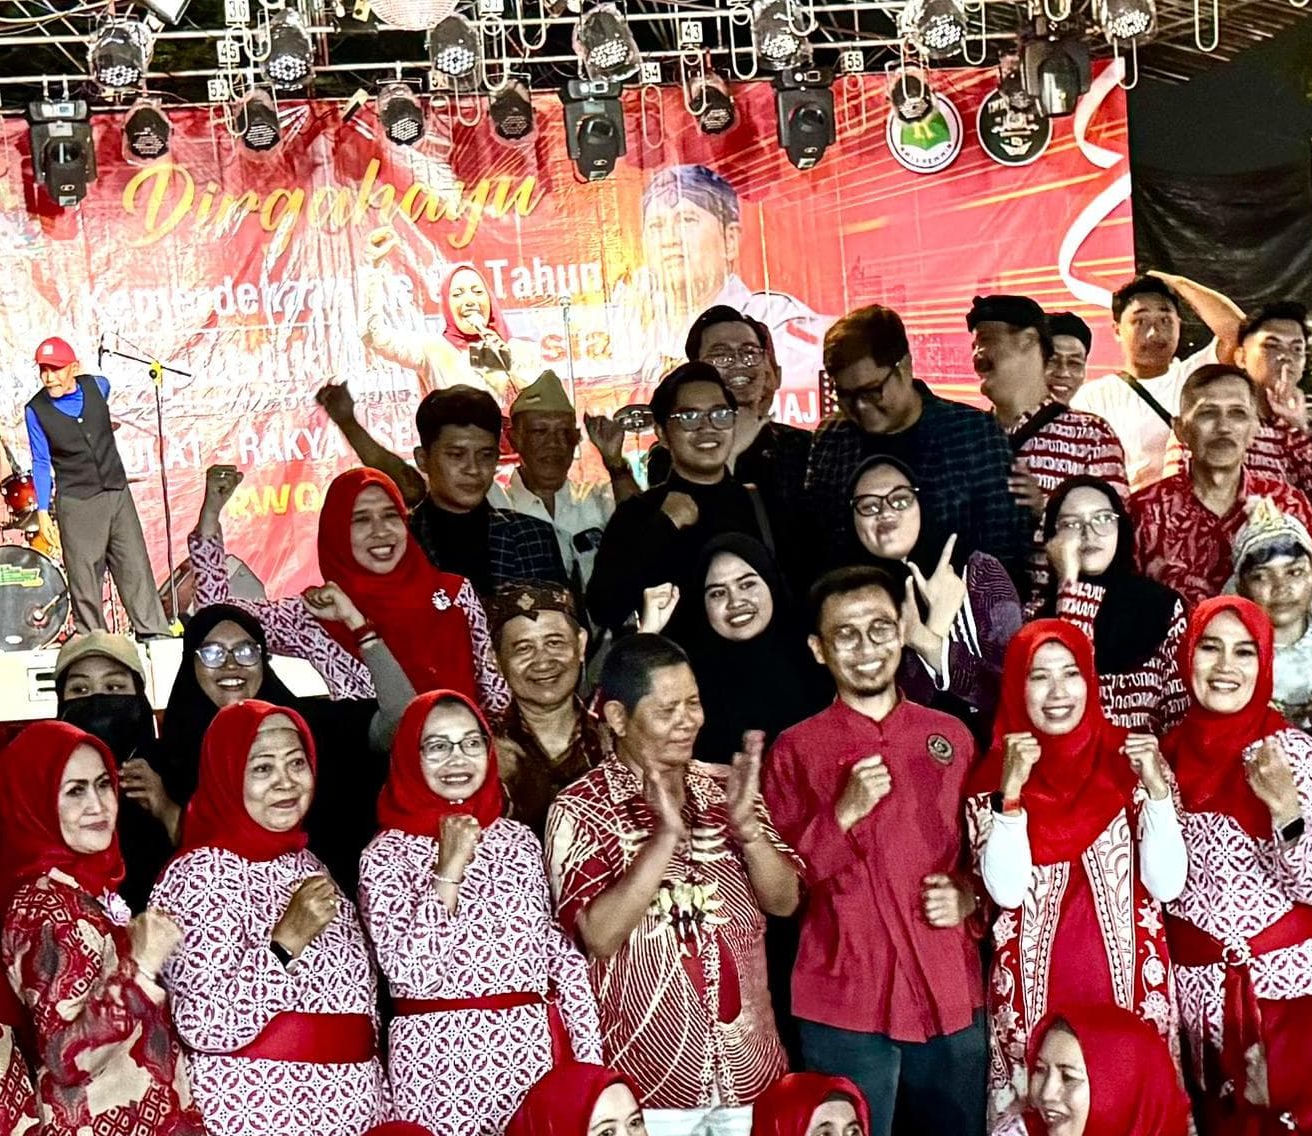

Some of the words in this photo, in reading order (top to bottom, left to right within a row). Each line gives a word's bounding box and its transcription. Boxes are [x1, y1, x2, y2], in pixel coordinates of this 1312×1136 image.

[847, 53, 862, 69] 55
[123, 159, 545, 249] Dirgahayu
[484, 256, 603, 300] Tahun
[237, 423, 347, 465] RAKYA
